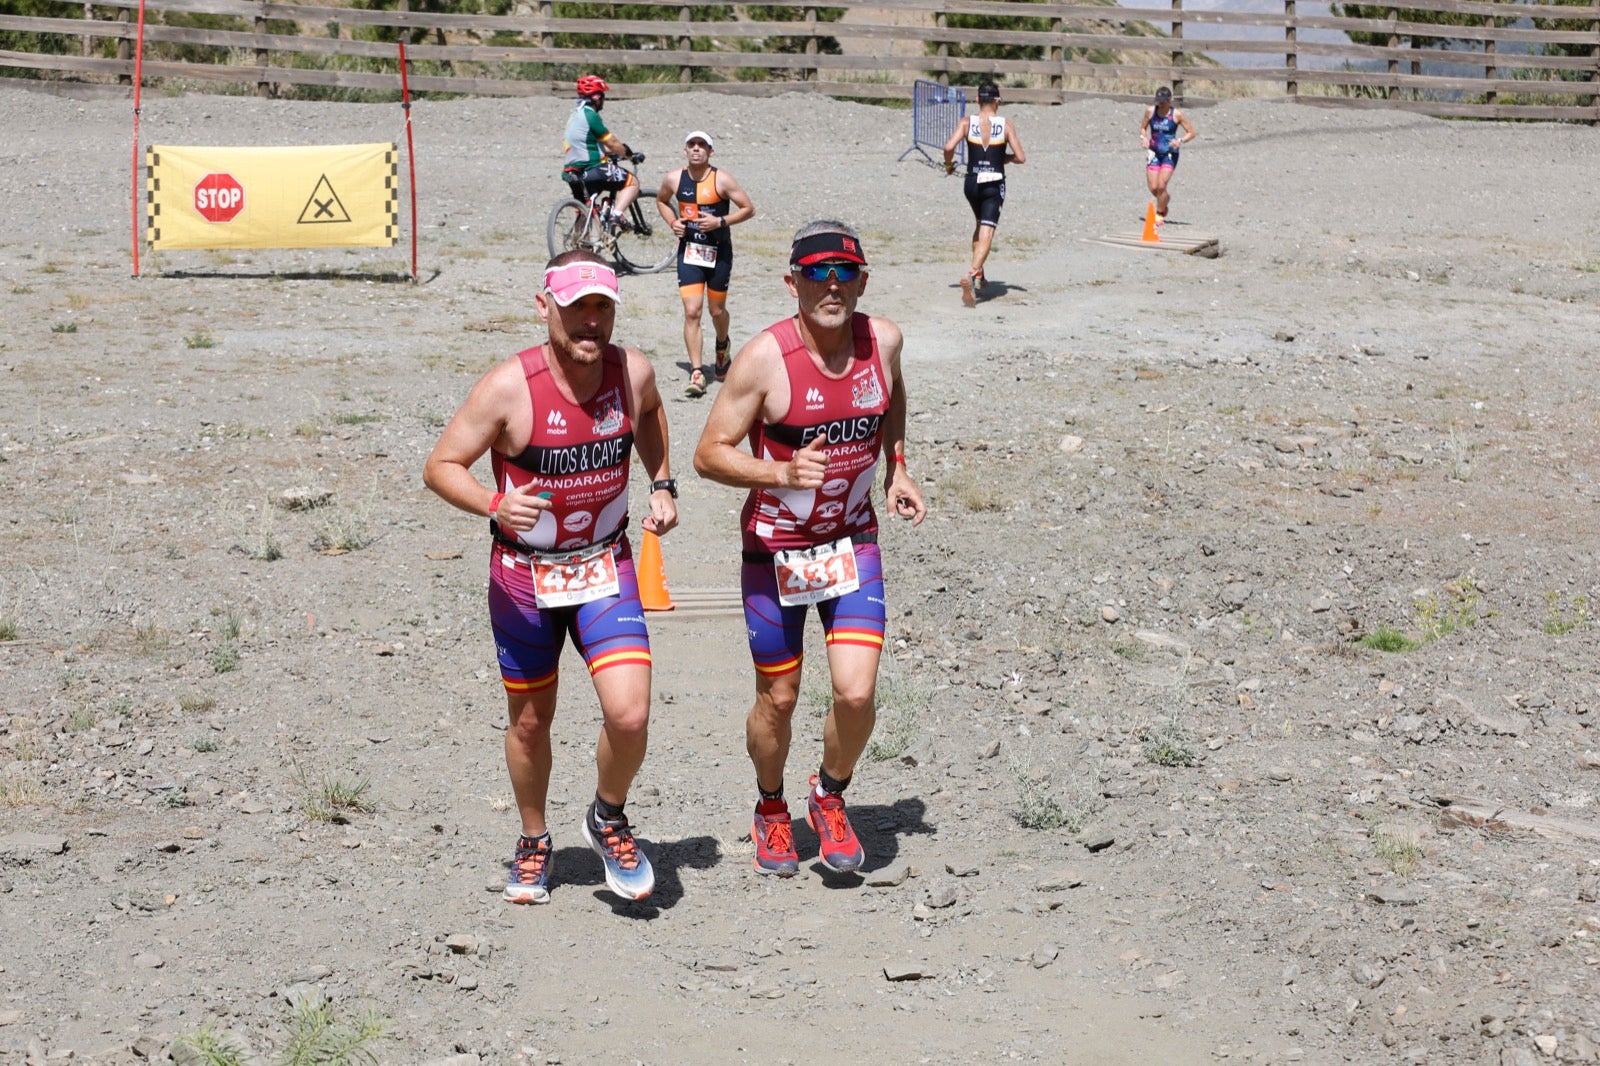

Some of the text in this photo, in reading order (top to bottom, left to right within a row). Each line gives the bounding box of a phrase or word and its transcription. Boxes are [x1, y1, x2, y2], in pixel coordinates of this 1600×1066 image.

[197, 188, 241, 208] STOP
[805, 403, 825, 411] mobel
[546, 427, 568, 435] mobel
[800, 416, 879, 447] ESCUSA
[540, 438, 623, 475] LITOS & CAYE
[826, 459, 849, 469] entro
[532, 467, 624, 490] MANDARACHE
[566, 491, 593, 501] centro
[543, 558, 608, 591] 423
[787, 557, 846, 591] 431
